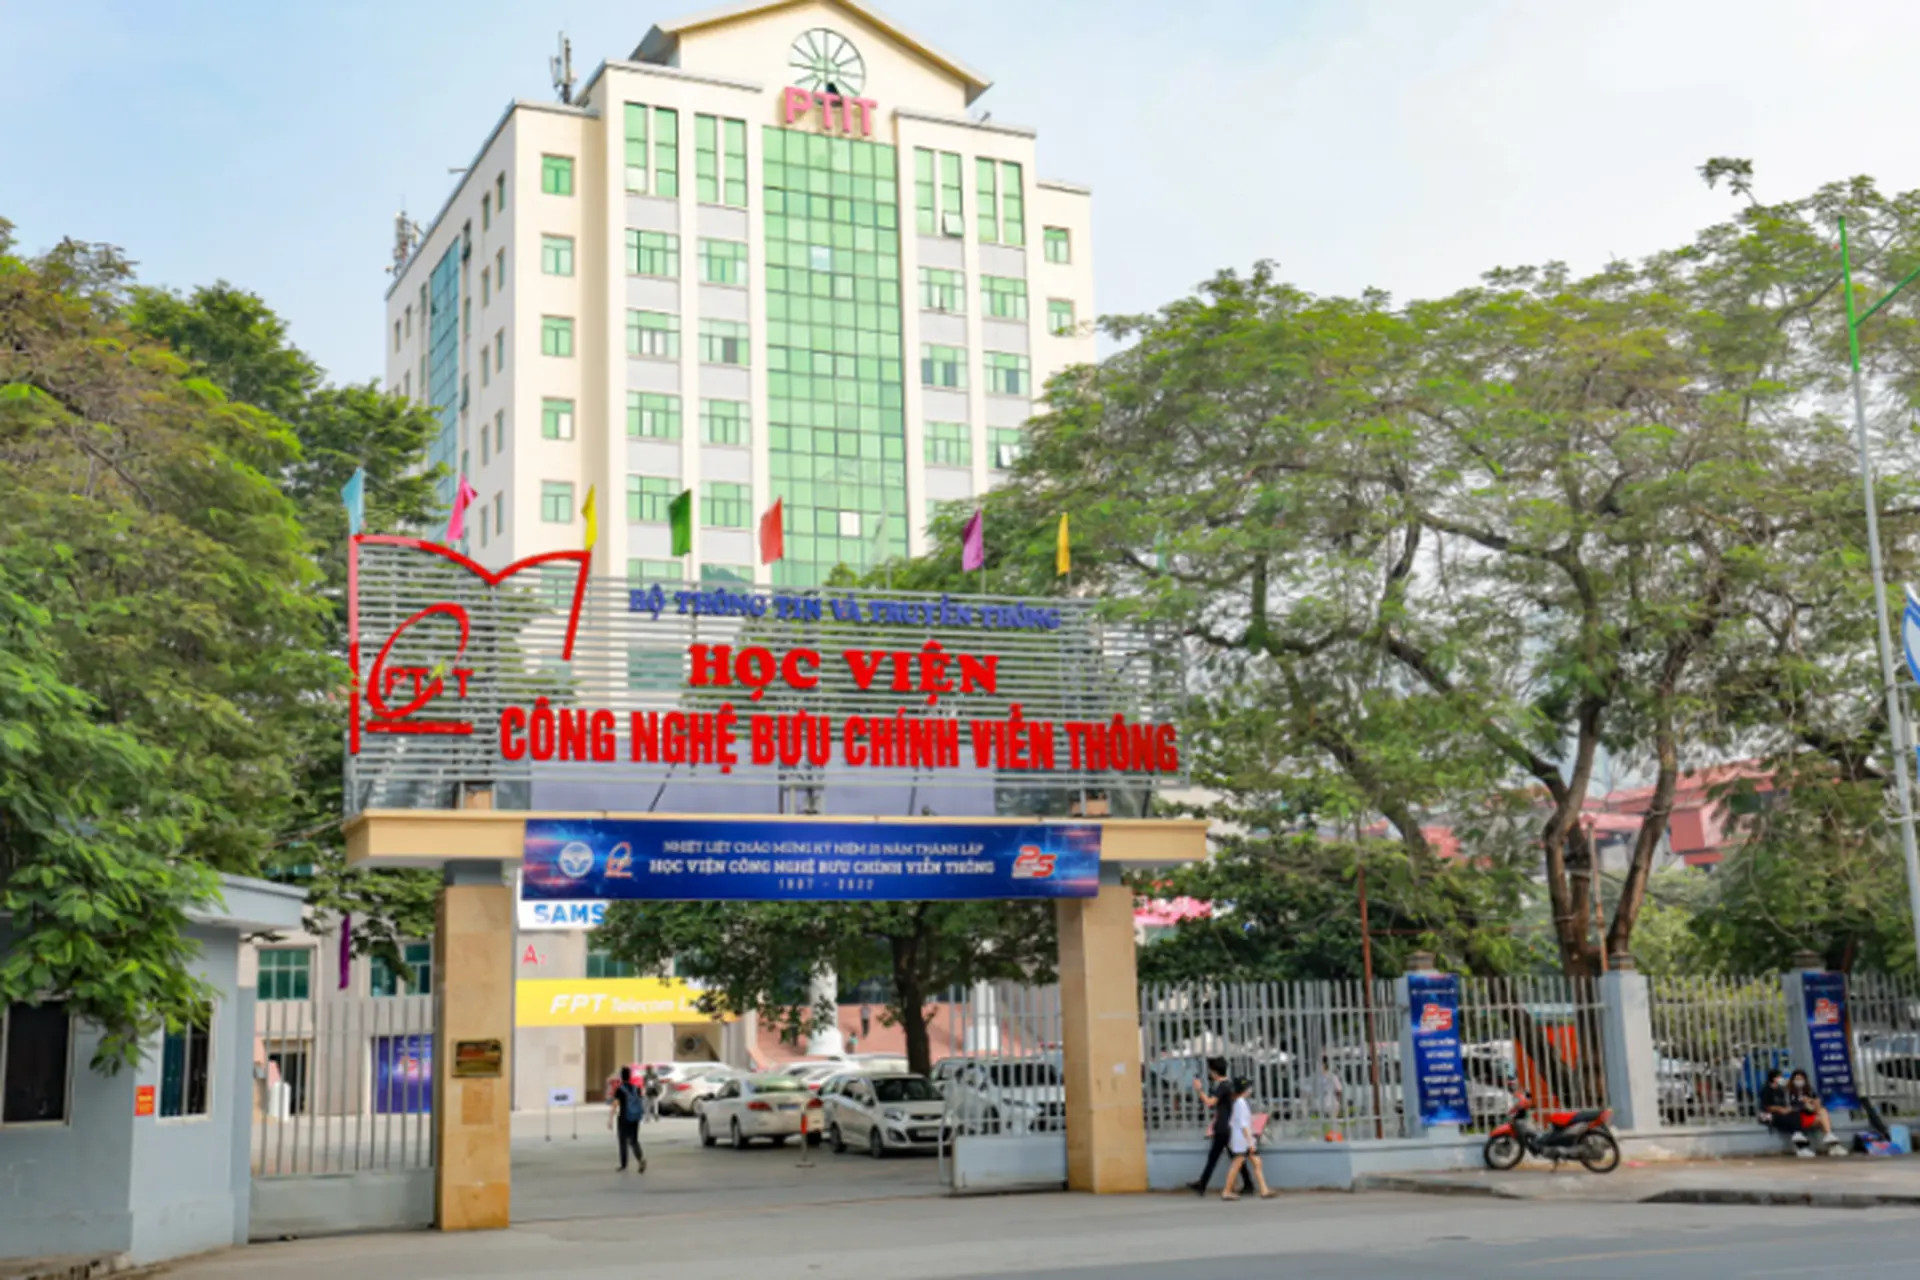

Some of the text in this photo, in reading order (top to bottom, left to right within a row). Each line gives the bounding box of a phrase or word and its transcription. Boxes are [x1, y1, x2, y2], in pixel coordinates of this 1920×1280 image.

[784, 86, 878, 136] PTIT
[629, 583, 665, 621] BỘ
[673, 587, 767, 617] THÔNG
[772, 594, 822, 621] TIN
[831, 591, 862, 622] VÀ
[689, 640, 999, 706] HỌC VIỆN
[501, 696, 1179, 775] CÔNG NGHỆ BƯU CHÍNH VIỄN THÔNG
[549, 993, 607, 1014] FPT
[611, 996, 674, 1013] Telecom
